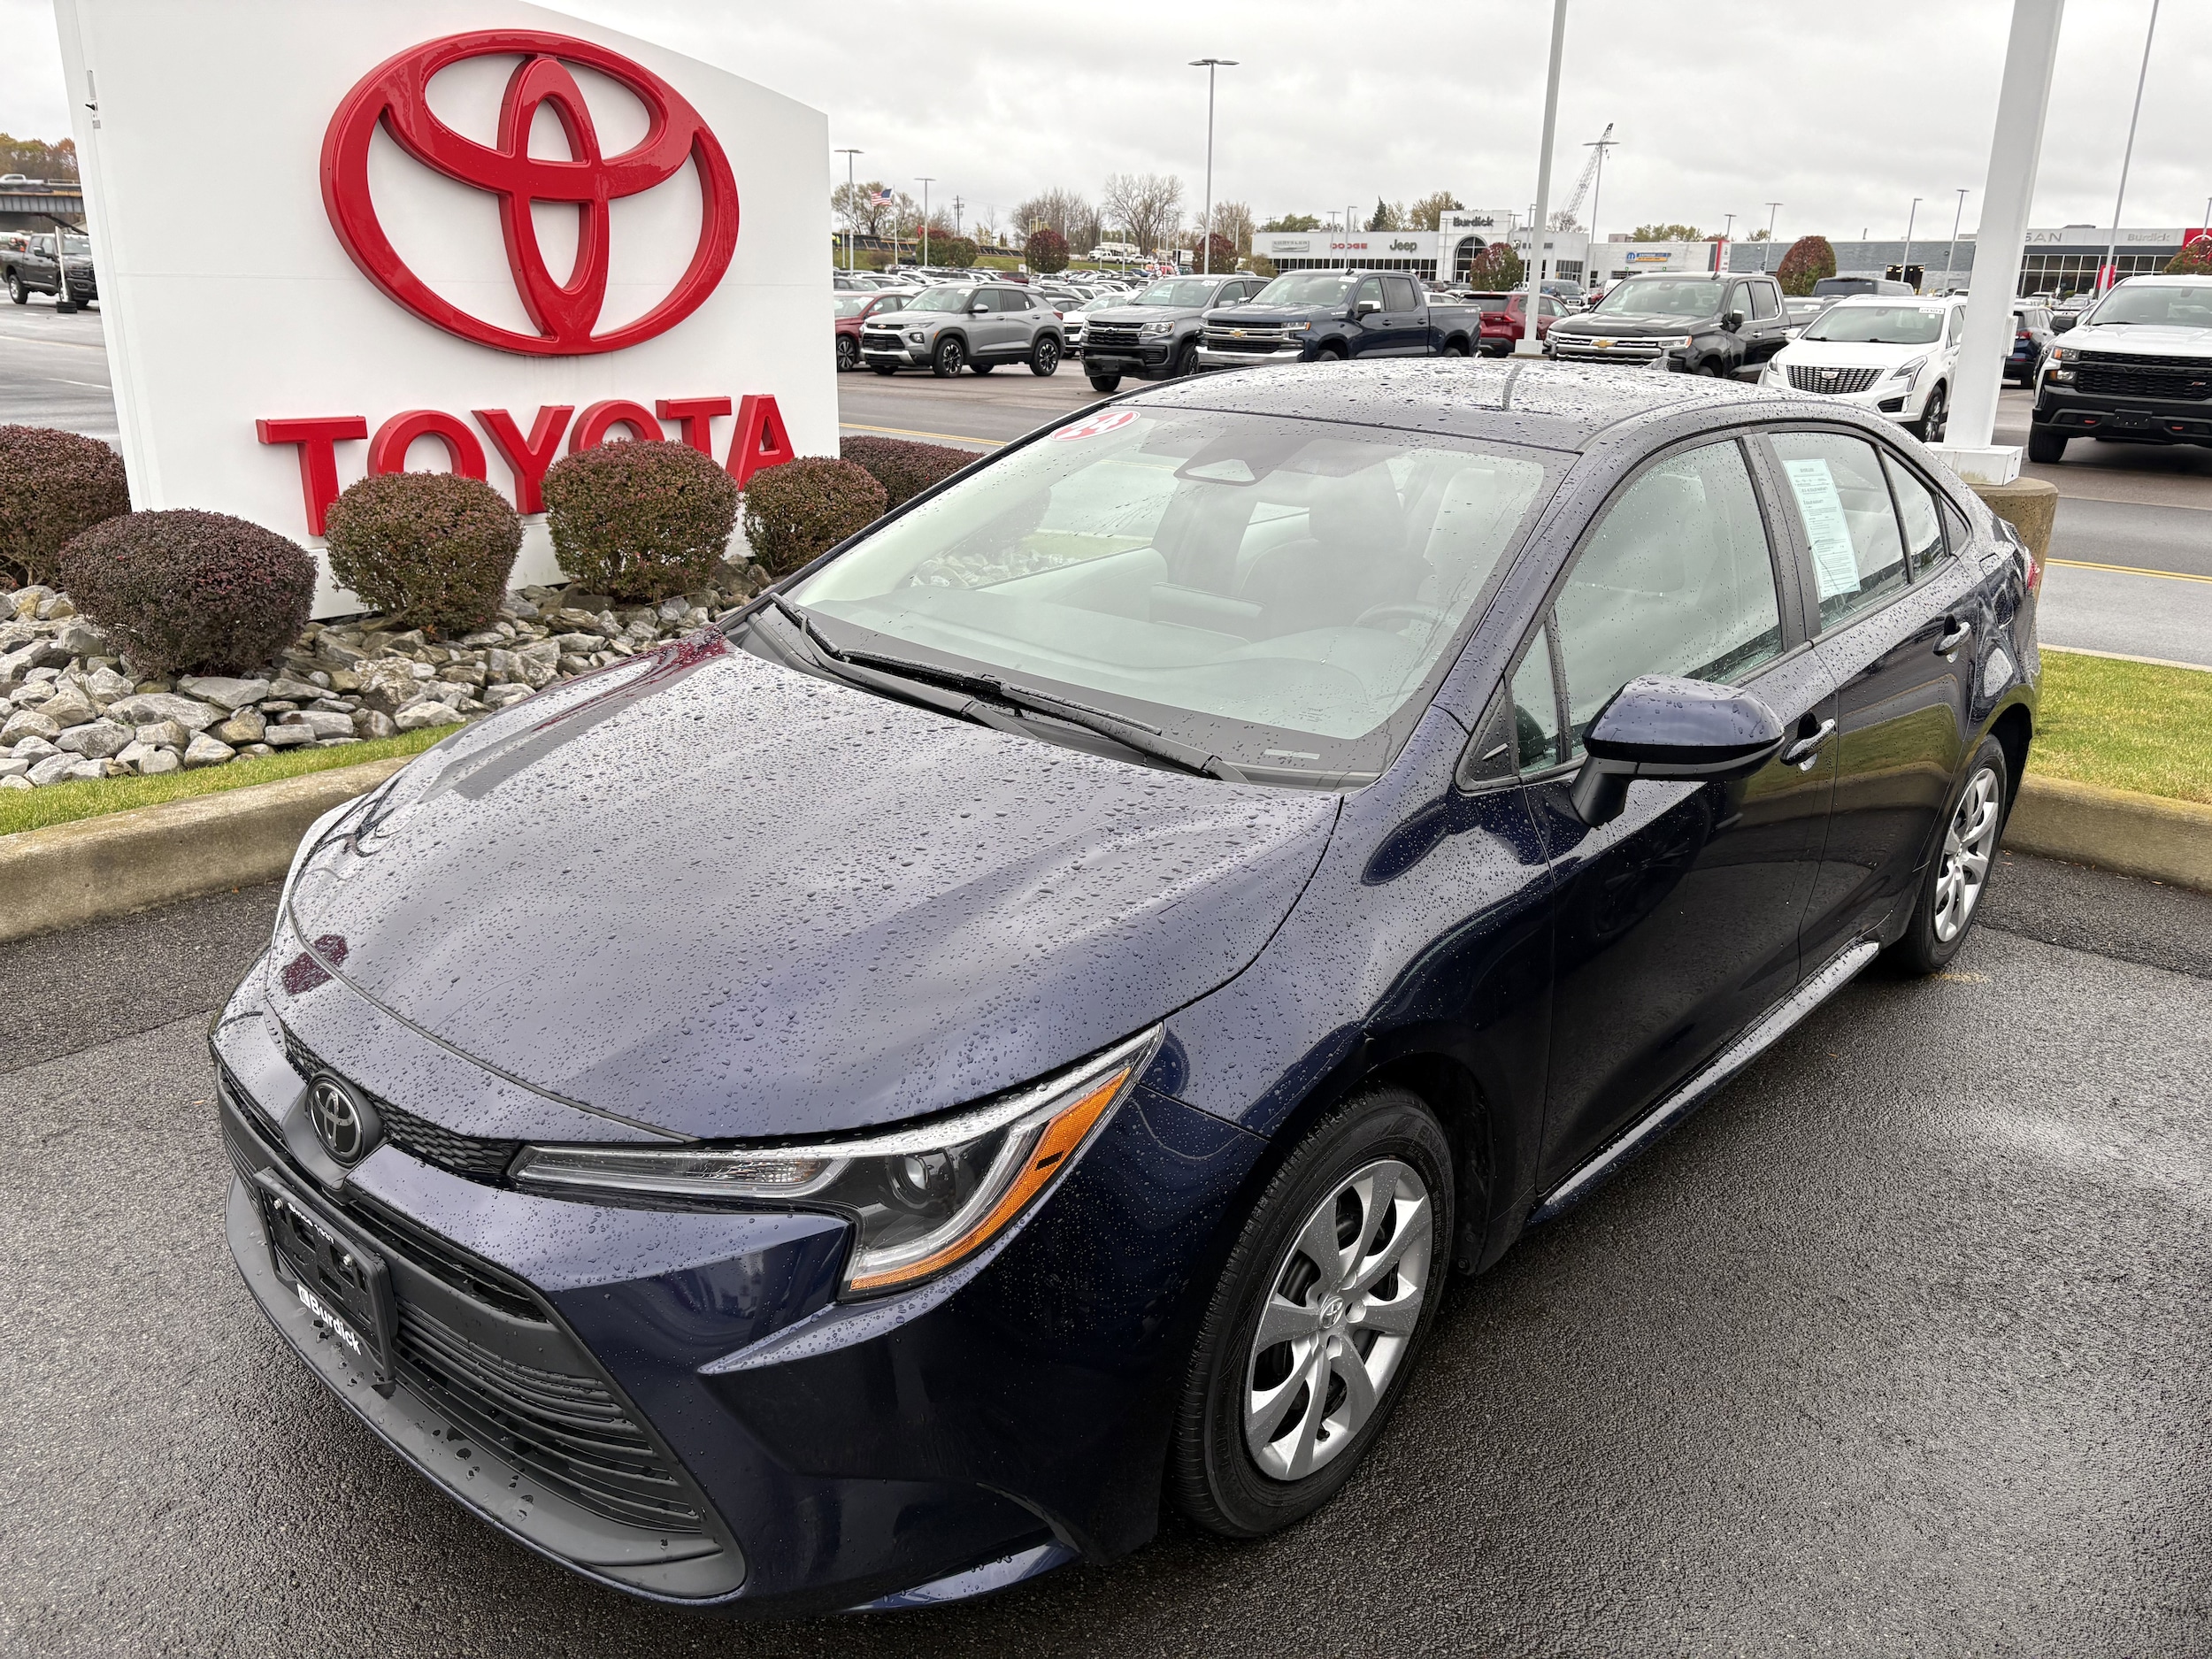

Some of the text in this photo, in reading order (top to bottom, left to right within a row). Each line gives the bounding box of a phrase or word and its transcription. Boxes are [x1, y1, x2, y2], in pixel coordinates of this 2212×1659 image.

[1453, 216, 1494, 227] Burdick
[2127, 233, 2170, 242] Burdick
[1389, 239, 1417, 253] Jeep
[1056, 411, 1133, 441] 24
[309, 1293, 362, 1356] Burdick
